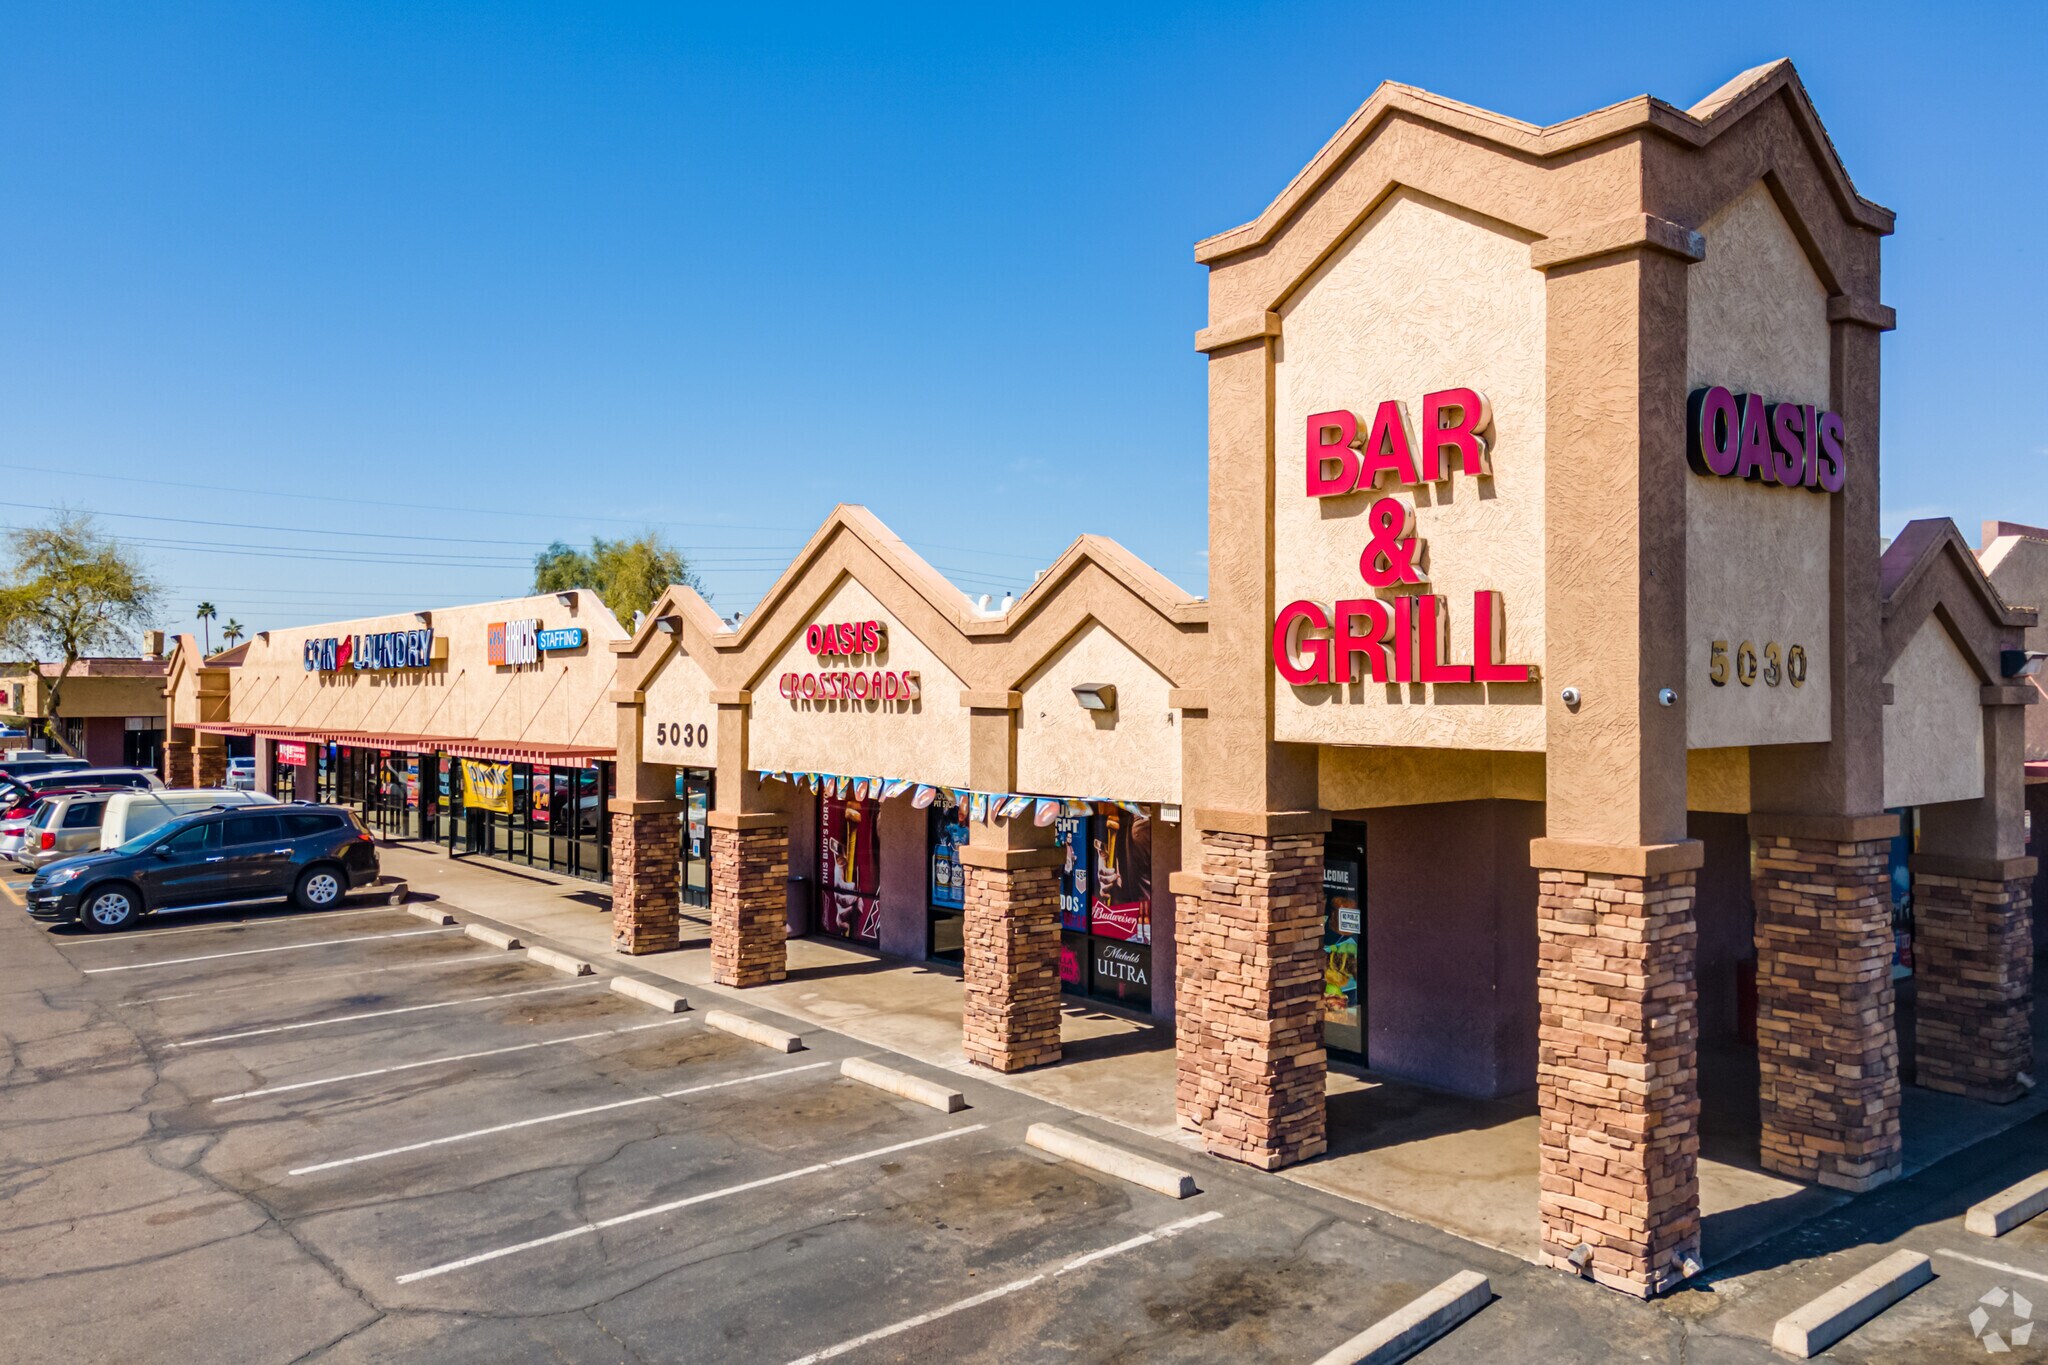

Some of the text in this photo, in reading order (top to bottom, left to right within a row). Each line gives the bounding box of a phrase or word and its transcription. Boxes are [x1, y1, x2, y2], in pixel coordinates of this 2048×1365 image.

[1305, 387, 1485, 498] BAR
[1699, 385, 1846, 493] OASIS
[1359, 497, 1424, 588] &
[303, 628, 434, 672] COIN LAUNDRY
[505, 619, 578, 665] ABACUS STAFFING
[806, 620, 880, 656] OASIS
[1273, 590, 1531, 686] GRILL
[1709, 640, 1808, 688] 5030
[779, 670, 913, 701] CROSSROADS
[657, 722, 709, 748] 5030
[1055, 817, 1080, 833] GHT
[1323, 869, 1349, 883] LCOME
[1092, 905, 1138, 924] Budweiser
[1097, 958, 1148, 985] ULTRA
[1103, 945, 1140, 964] Michelob
